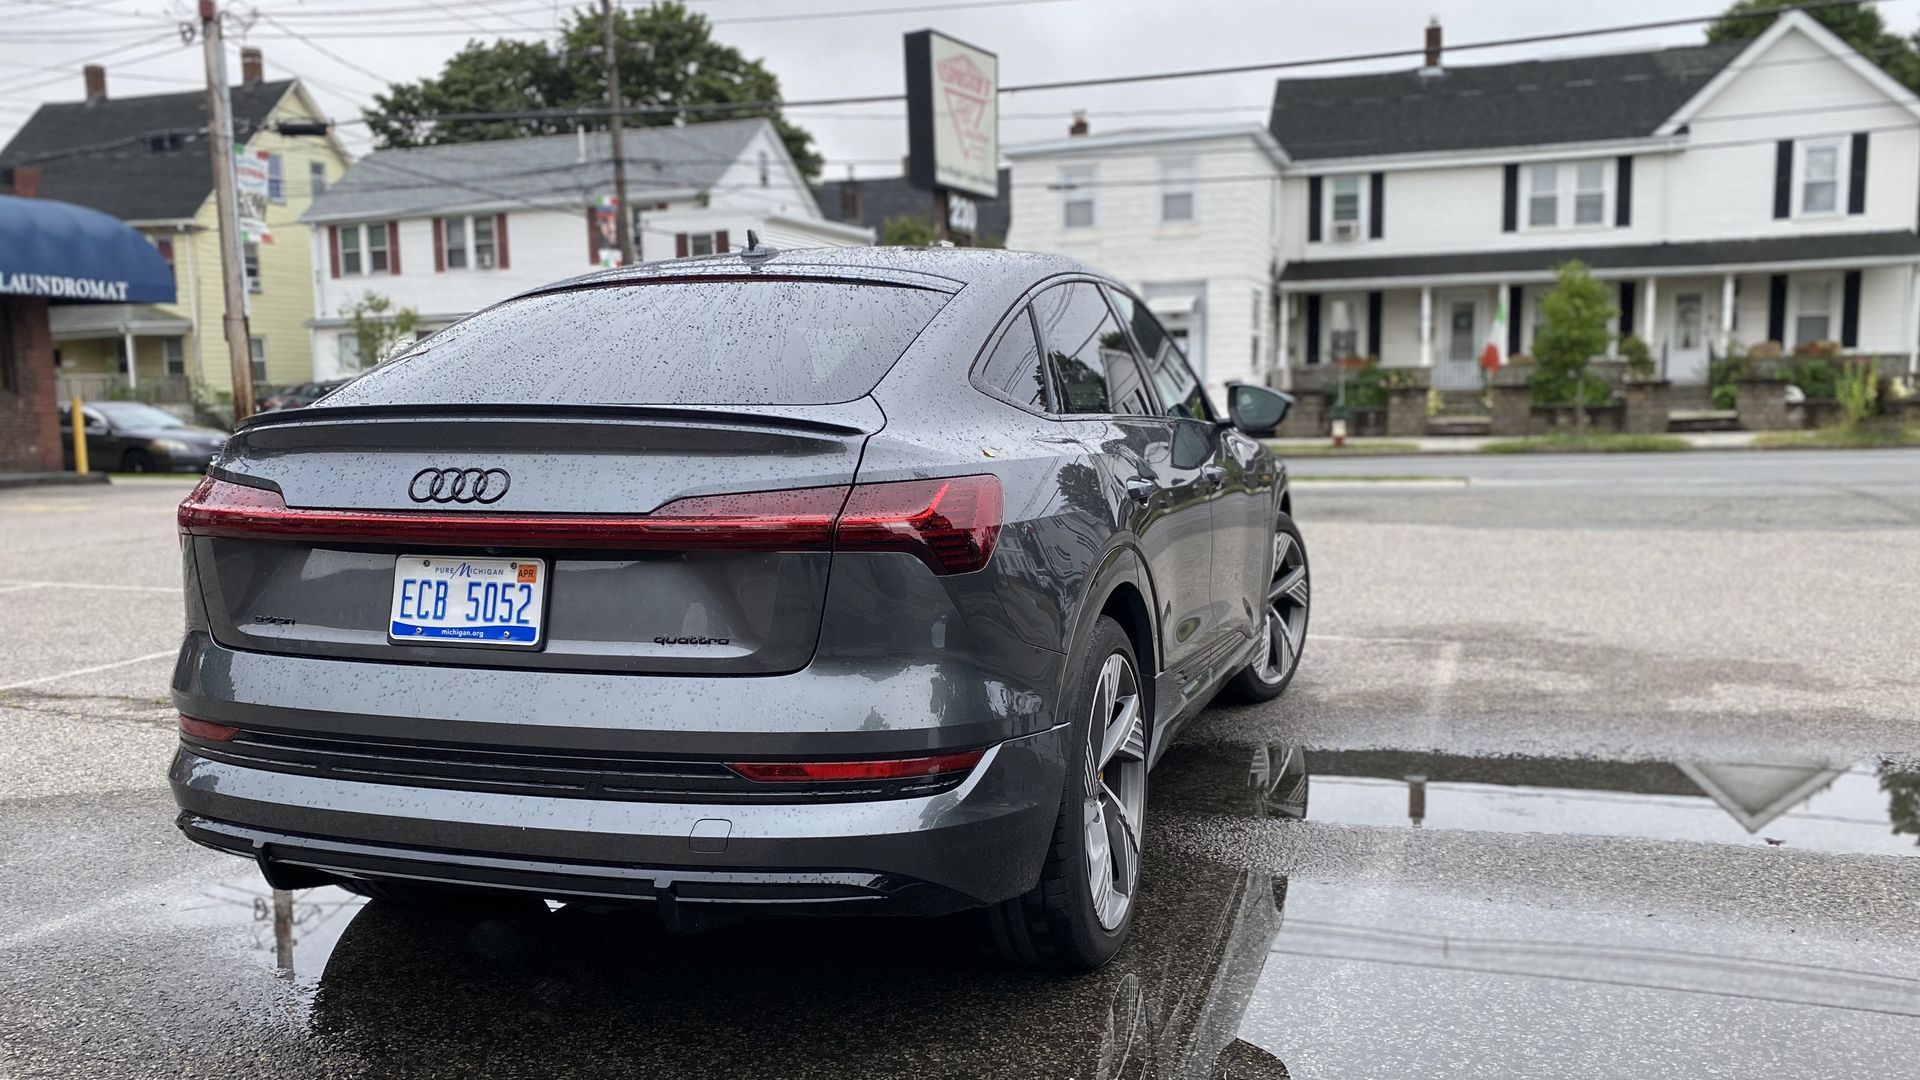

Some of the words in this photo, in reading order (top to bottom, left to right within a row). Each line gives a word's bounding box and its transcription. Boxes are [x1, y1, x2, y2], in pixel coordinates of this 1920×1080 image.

[0, 270, 129, 300] LAUNDROMAT
[435, 566, 454, 574] PURE
[517, 568, 534, 578] APR
[400, 578, 449, 620] ECB
[465, 580, 532, 624] 5052
[441, 628, 484, 638] michigan.org
[653, 636, 730, 645] quattro
